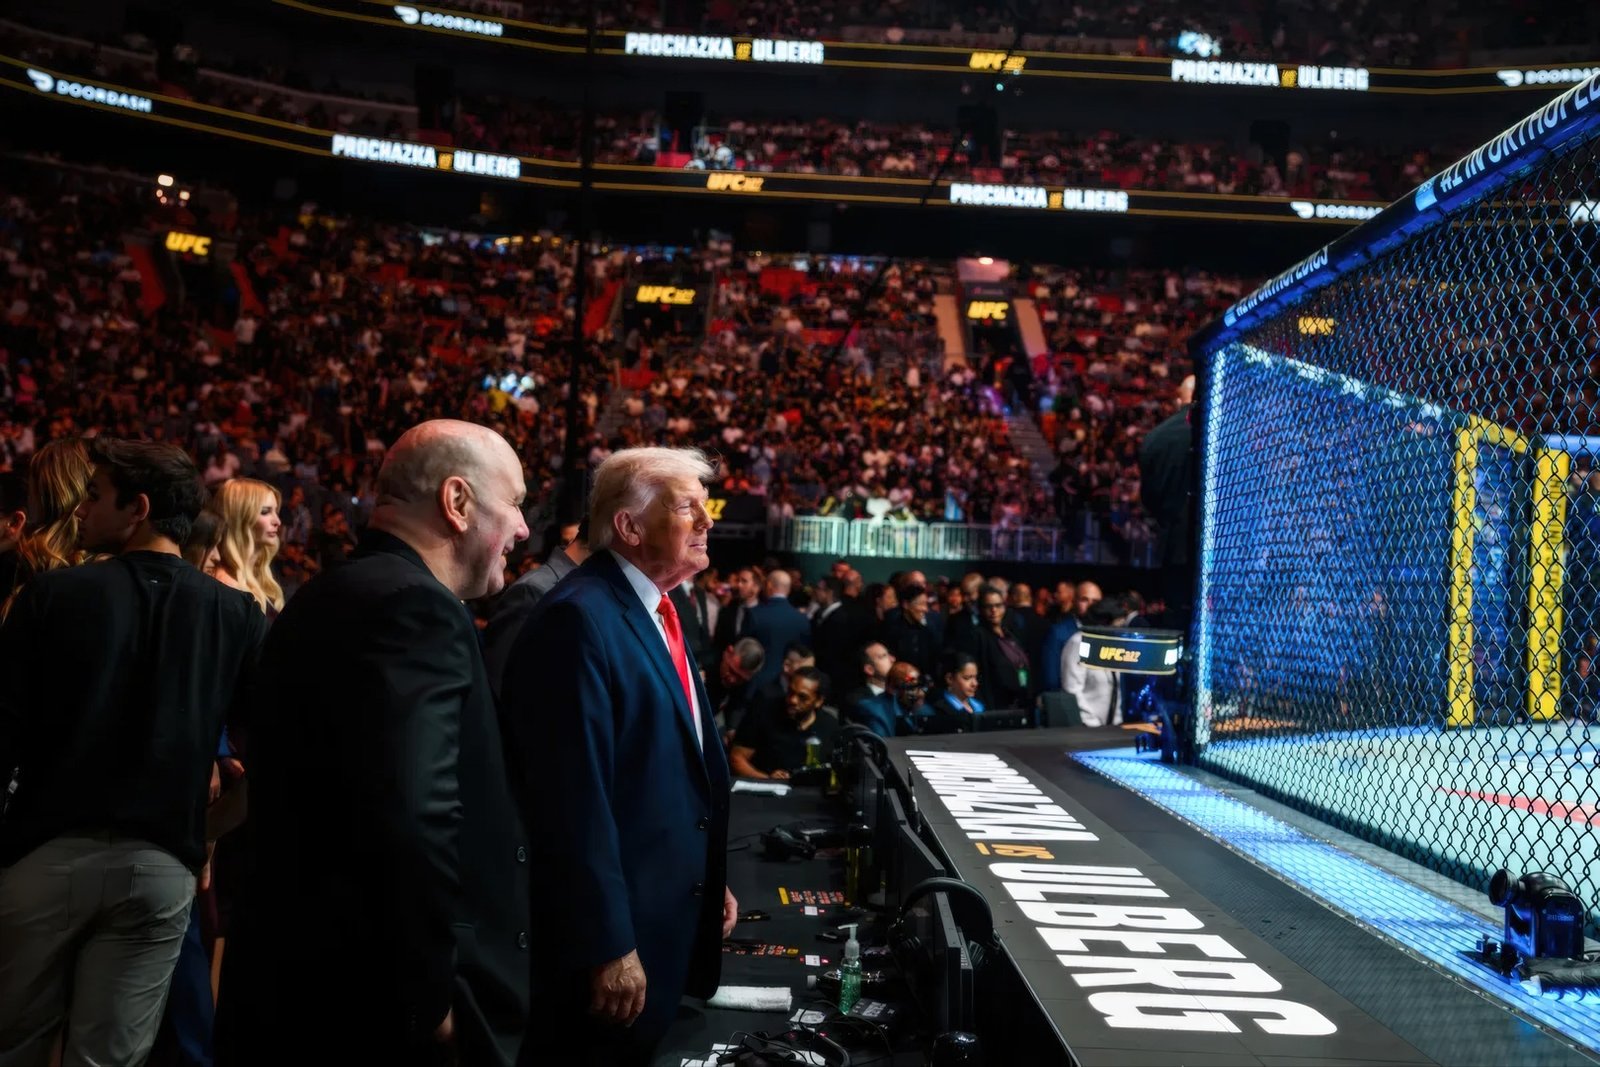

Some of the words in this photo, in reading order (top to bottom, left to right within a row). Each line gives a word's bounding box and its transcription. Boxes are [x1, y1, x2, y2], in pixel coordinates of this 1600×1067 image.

[421, 11, 503, 36] DOORDASH
[625, 32, 734, 60] PROCHAZKA
[752, 38, 825, 65] ULBERG
[1171, 58, 1280, 87] PROCHAZKA
[1298, 64, 1370, 92] ULBERG
[56, 79, 152, 113] DOORDASH
[332, 134, 437, 169] PROCHAZKA
[453, 149, 521, 180] ULBERG
[950, 183, 1048, 209] PROCHAZKA
[165, 231, 212, 256] UFC
[967, 300, 1009, 320] UFC
[1099, 646, 1126, 662] UFC
[905, 750, 1100, 841] PROCHAZKA
[988, 862, 1338, 1036] ULBERG
